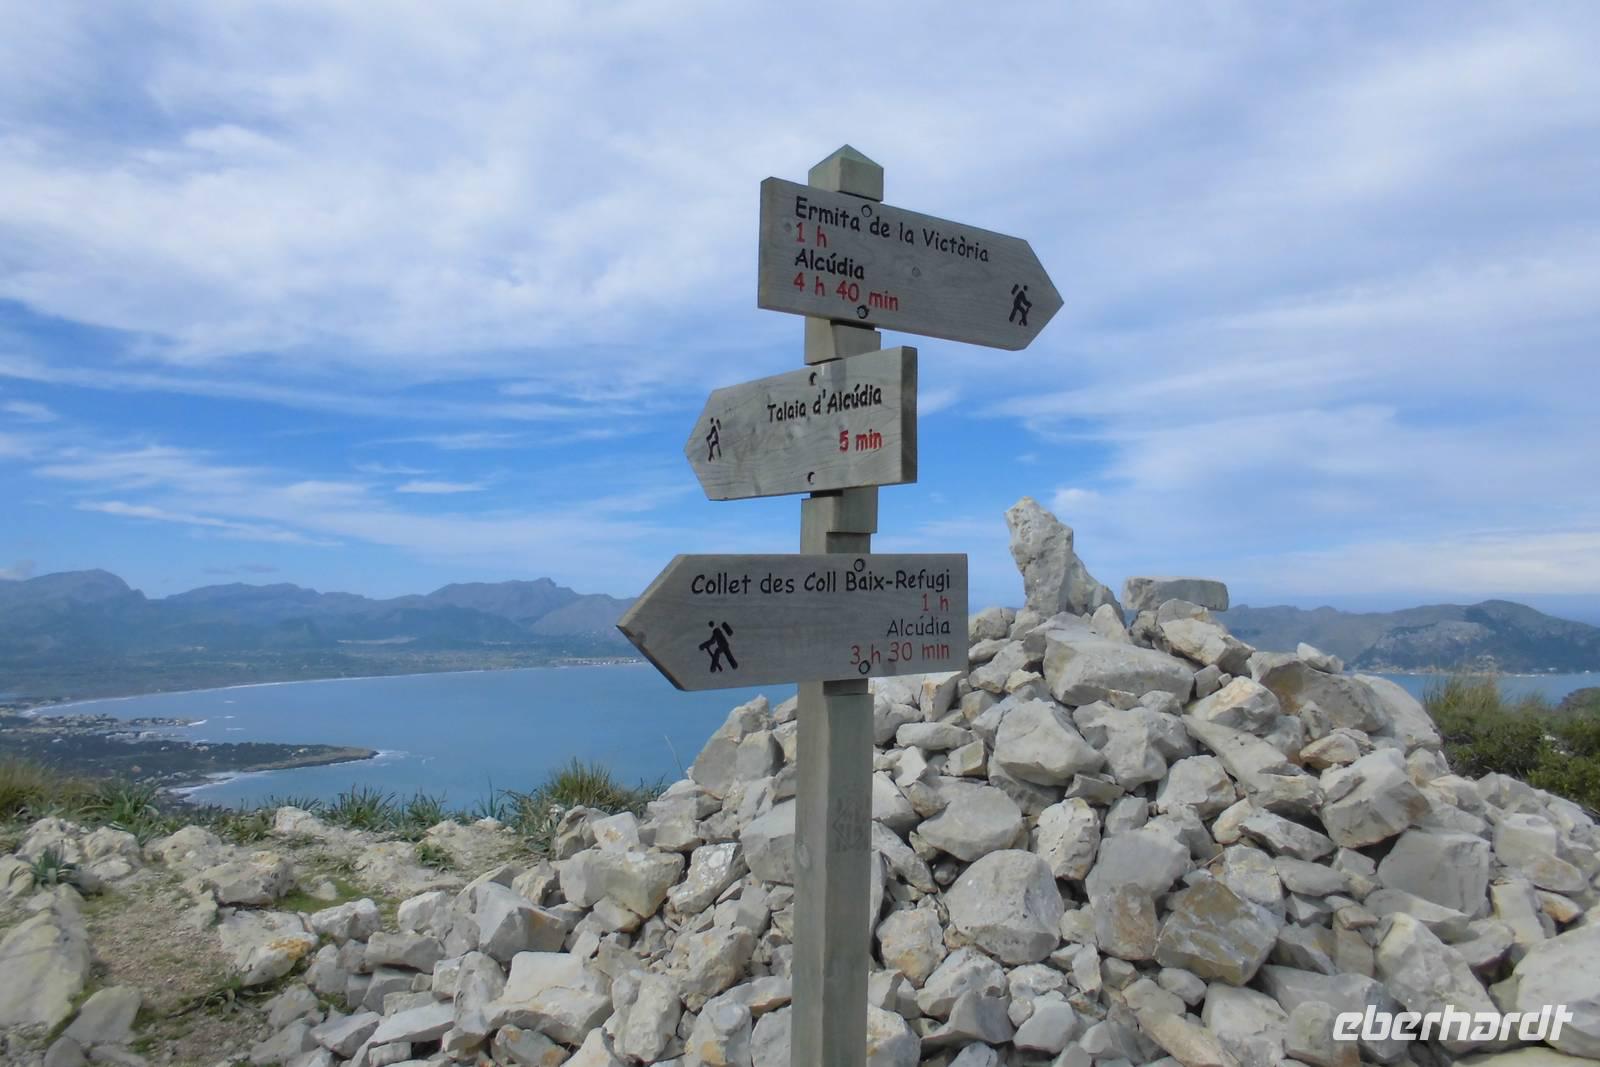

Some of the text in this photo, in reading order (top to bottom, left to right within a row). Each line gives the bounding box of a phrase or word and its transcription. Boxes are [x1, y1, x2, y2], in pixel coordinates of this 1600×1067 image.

[795, 195, 989, 262] Ermita de la Victòria
[796, 222, 827, 248] 1 h
[795, 248, 865, 280] Alcúdia
[793, 272, 899, 311] 4 h 40 min
[767, 384, 882, 423] Talaia d'Alcúdia
[839, 429, 882, 452] 5 min
[691, 569, 950, 595] Collet des Coll Baix-Refugi
[922, 594, 949, 612] 1 h
[886, 616, 950, 637] Alcúdia
[850, 641, 949, 665] 3 h 30 min
